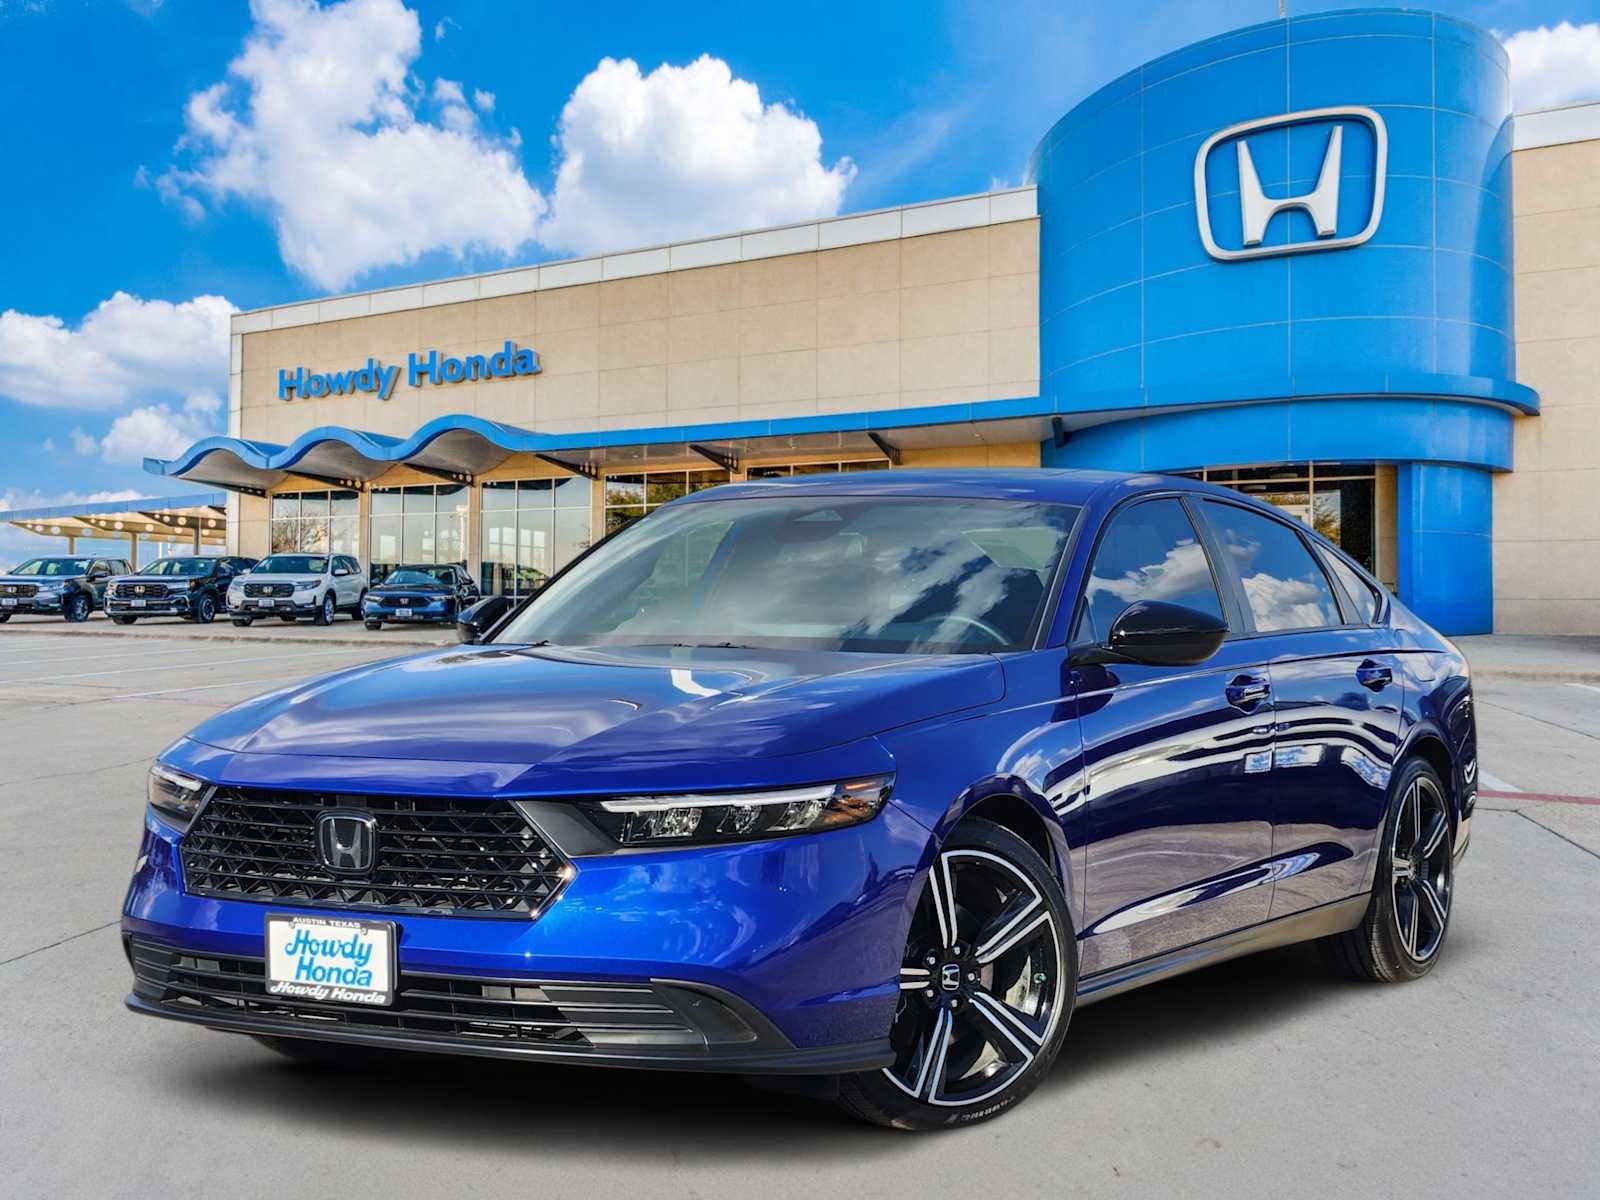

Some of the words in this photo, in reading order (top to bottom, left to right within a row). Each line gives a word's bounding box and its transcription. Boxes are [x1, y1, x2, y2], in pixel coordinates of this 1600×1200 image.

[278, 357, 400, 401] Howdy
[408, 340, 543, 388] Honda
[329, 919, 361, 929] TEXAS
[285, 929, 373, 967] Howdy
[295, 955, 373, 987] Honda
[270, 981, 328, 1000] Howdy
[331, 988, 386, 1004] Honda
